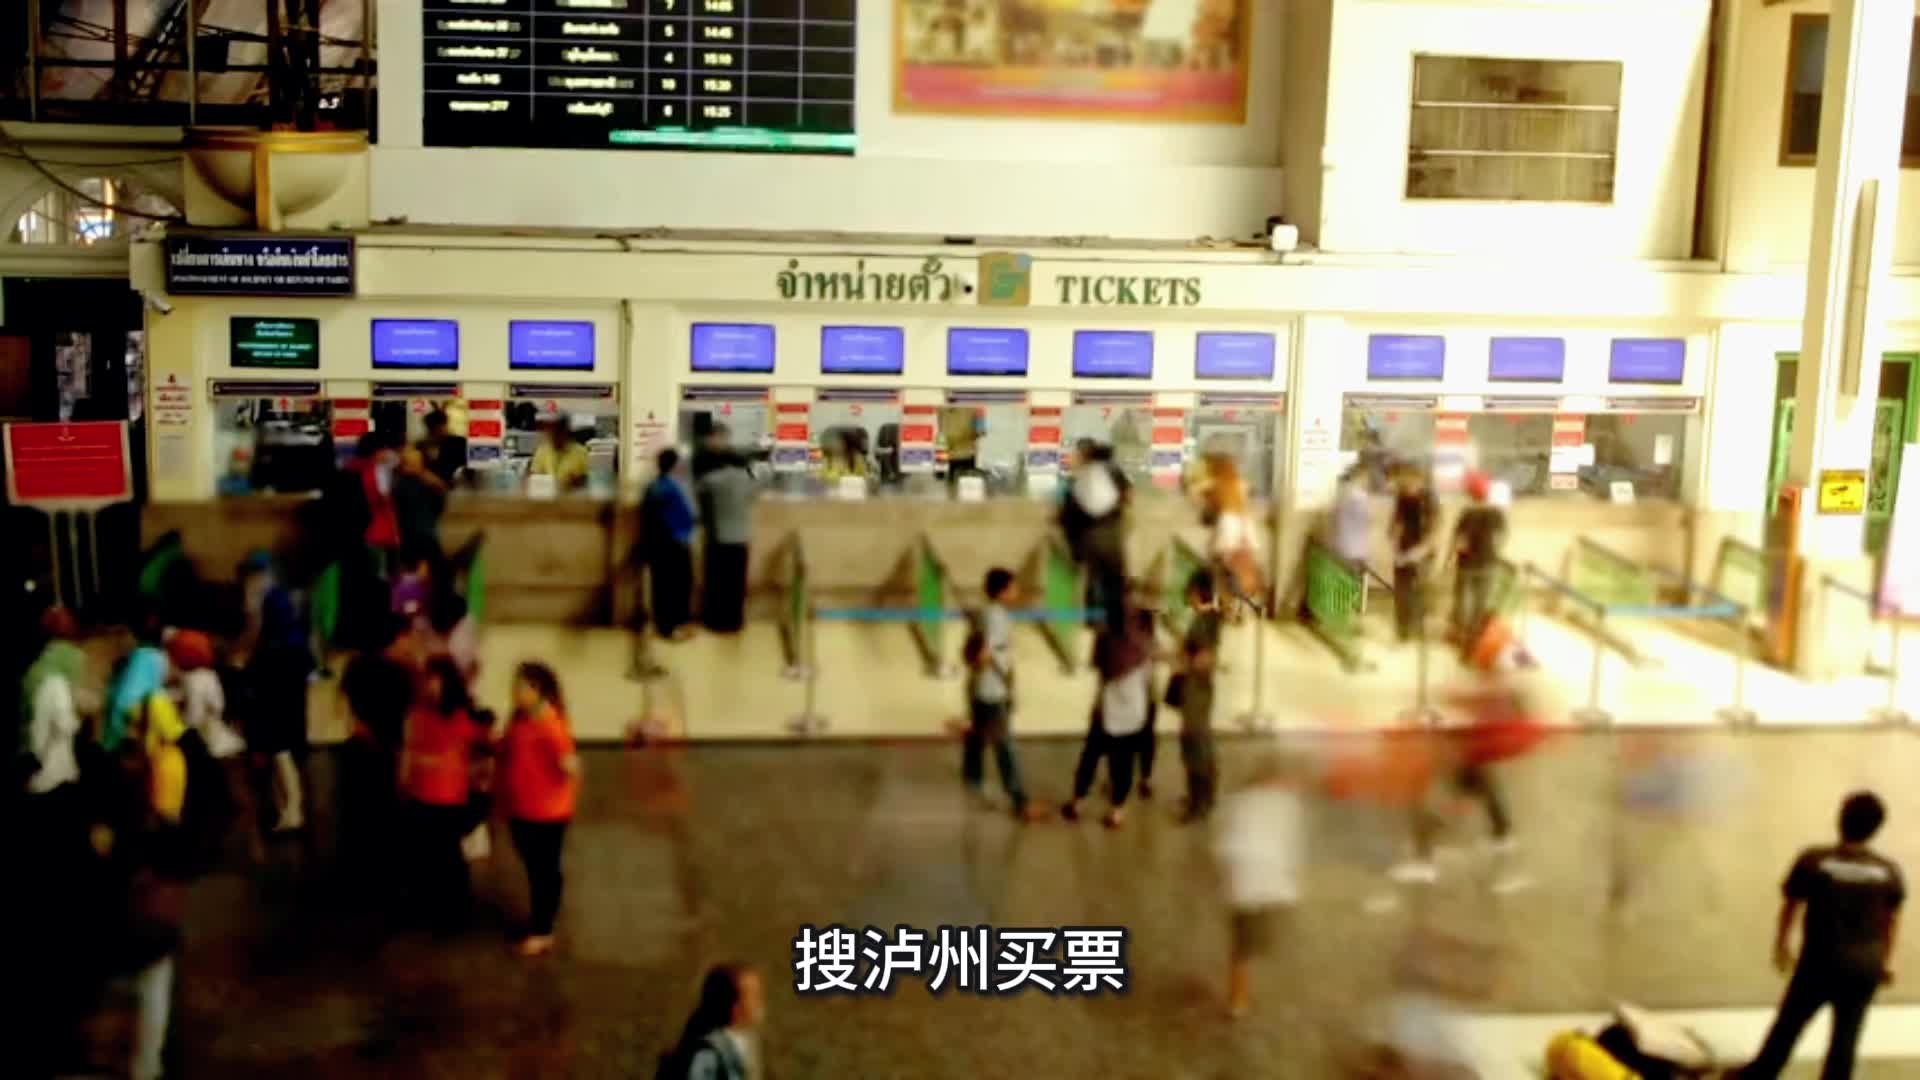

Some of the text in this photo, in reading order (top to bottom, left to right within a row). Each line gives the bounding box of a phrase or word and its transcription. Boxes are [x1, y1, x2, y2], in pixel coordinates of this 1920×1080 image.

[777, 256, 952, 302] จำหน่ายตั๋ว
[1056, 275, 1201, 306] TICKETS
